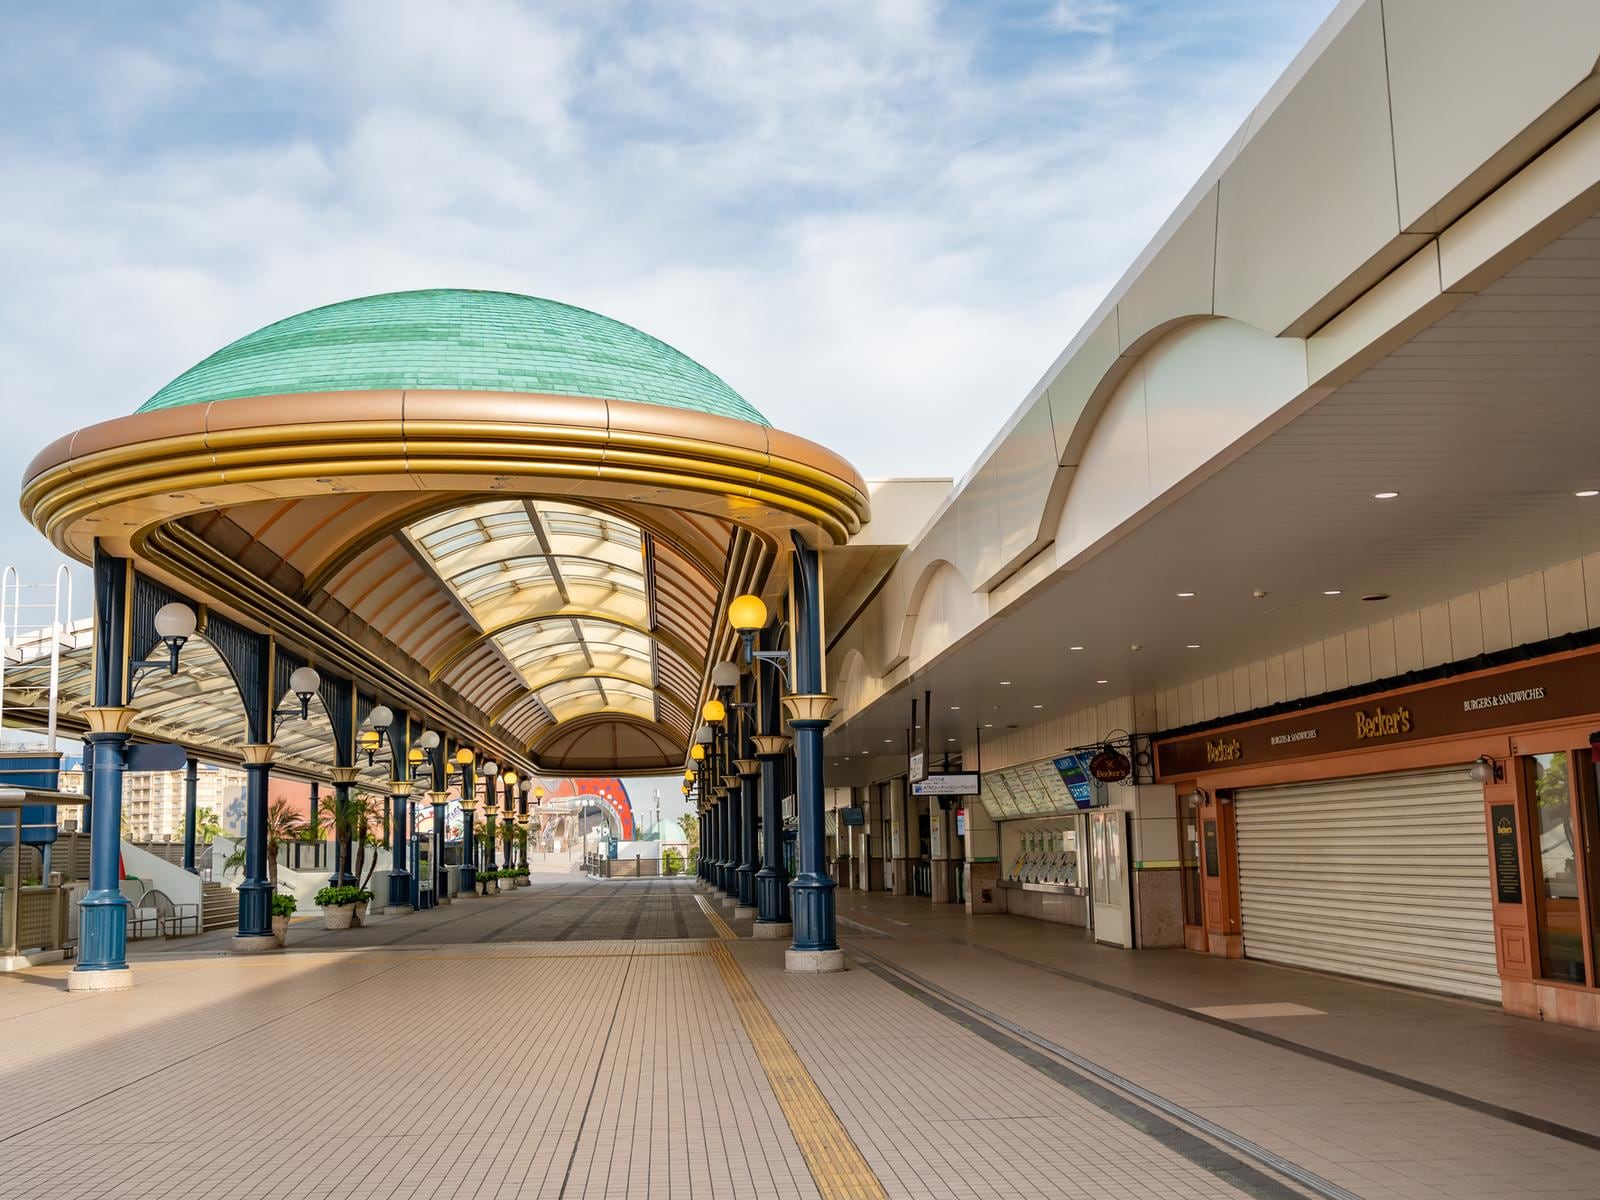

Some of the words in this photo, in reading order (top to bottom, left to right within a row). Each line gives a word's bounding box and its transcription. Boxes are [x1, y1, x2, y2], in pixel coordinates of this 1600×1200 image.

[1464, 697, 1492, 711] BURGERS
[1492, 696, 1498, 706] &
[1499, 687, 1544, 704] SANDWICHES
[1355, 706, 1410, 739] Becker's
[1271, 735, 1287, 745] BURGERS
[1291, 729, 1317, 741] SANDWICHES
[1206, 739, 1240, 763] Becker's
[1096, 769, 1126, 778] Becker's
